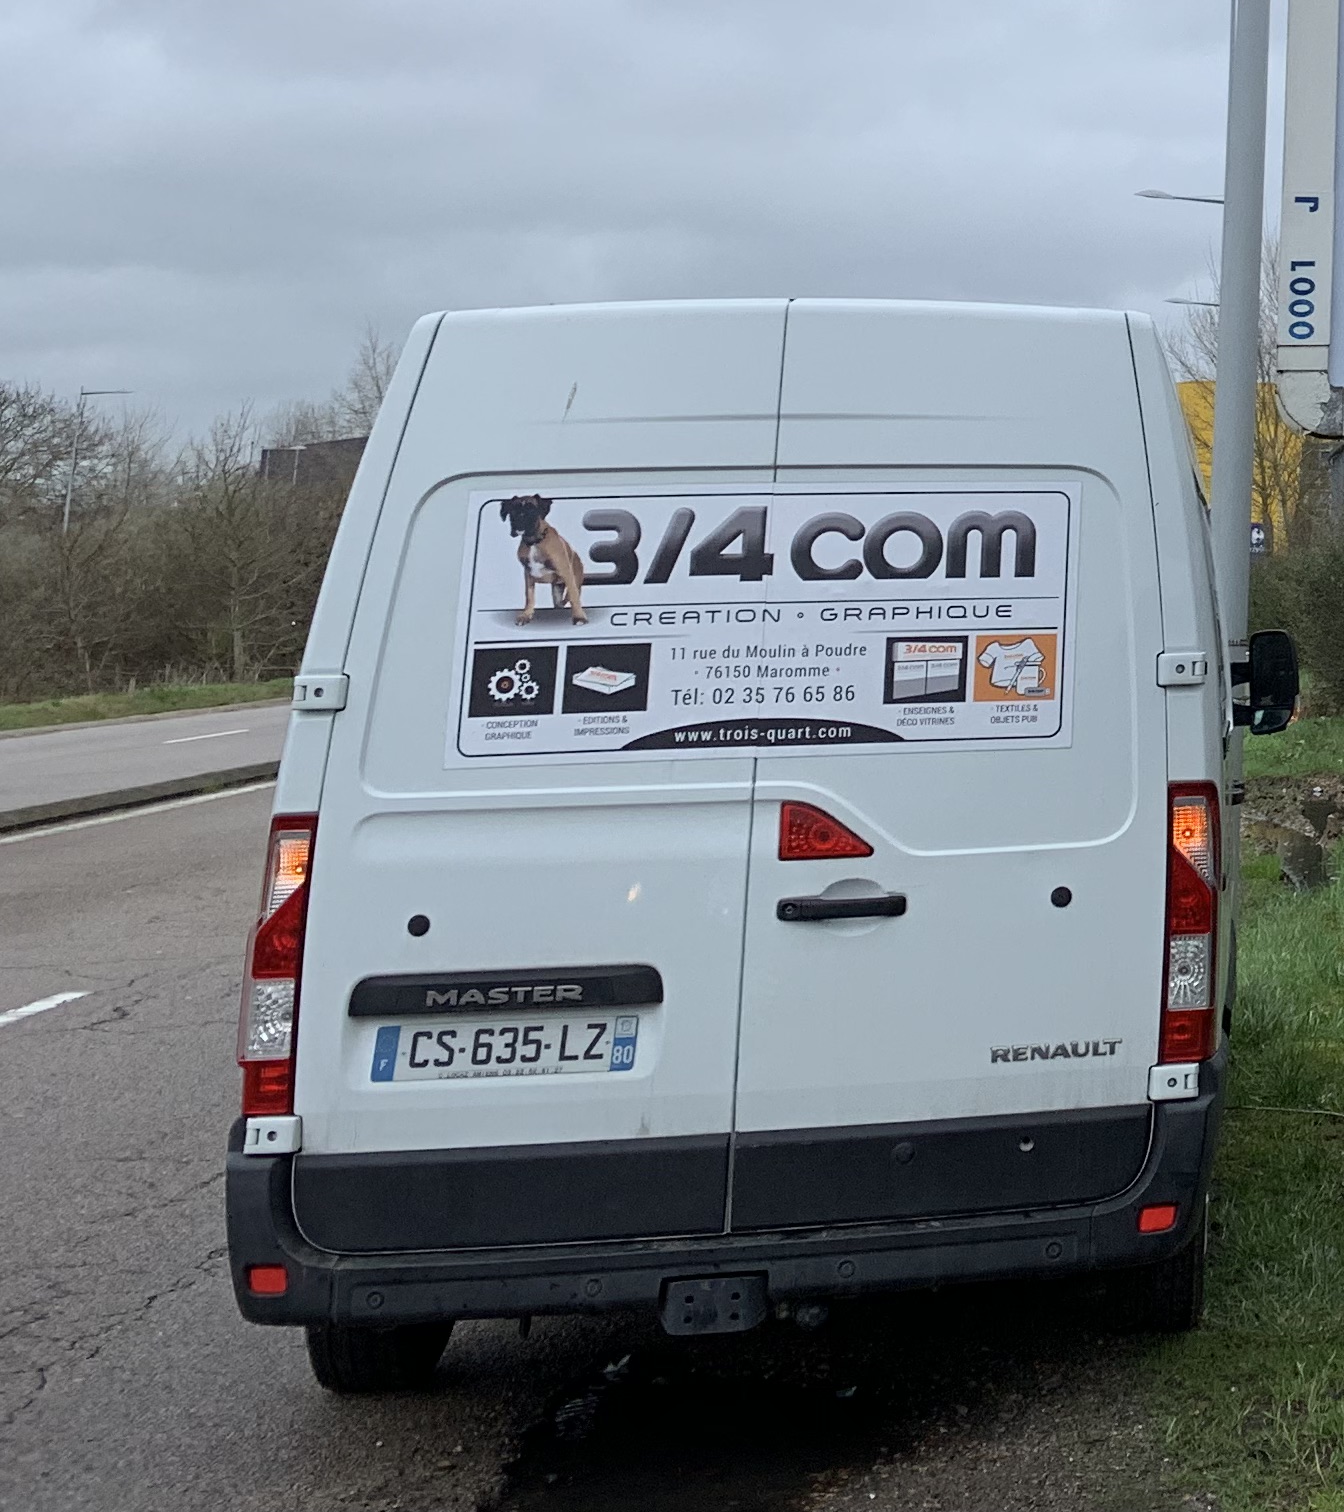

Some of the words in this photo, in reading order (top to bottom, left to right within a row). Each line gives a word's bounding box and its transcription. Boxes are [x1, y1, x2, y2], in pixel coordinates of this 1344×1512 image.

[581, 505, 774, 585] 3/4
[610, 608, 782, 627] CREATION
[820, 603, 1014, 623] GRAPHIQUE
[671, 647, 686, 660] 11
[693, 649, 716, 660] rue
[722, 645, 740, 658] du
[745, 643, 796, 658] Moulin
[801, 644, 809, 658] à
[815, 642, 867, 657] Poudre
[705, 665, 751, 679] 76150
[756, 665, 830, 678] Maromme
[712, 688, 735, 705] 02
[742, 687, 765, 704] 35
[773, 687, 795, 703] 76
[803, 686, 825, 702] 65
[833, 685, 855, 701] 86
[486, 719, 538, 729] CONCEPTION
[674, 725, 851, 743] www.trois-quart.com
[484, 731, 532, 740] GRAPHIQUE
[426, 984, 583, 1008] MASTER
[409, 1022, 608, 1069] CS-635-LZ
[612, 1045, 633, 1065] 80
[990, 1038, 1123, 1064] RENAULT
[378, 1059, 387, 1072] F
